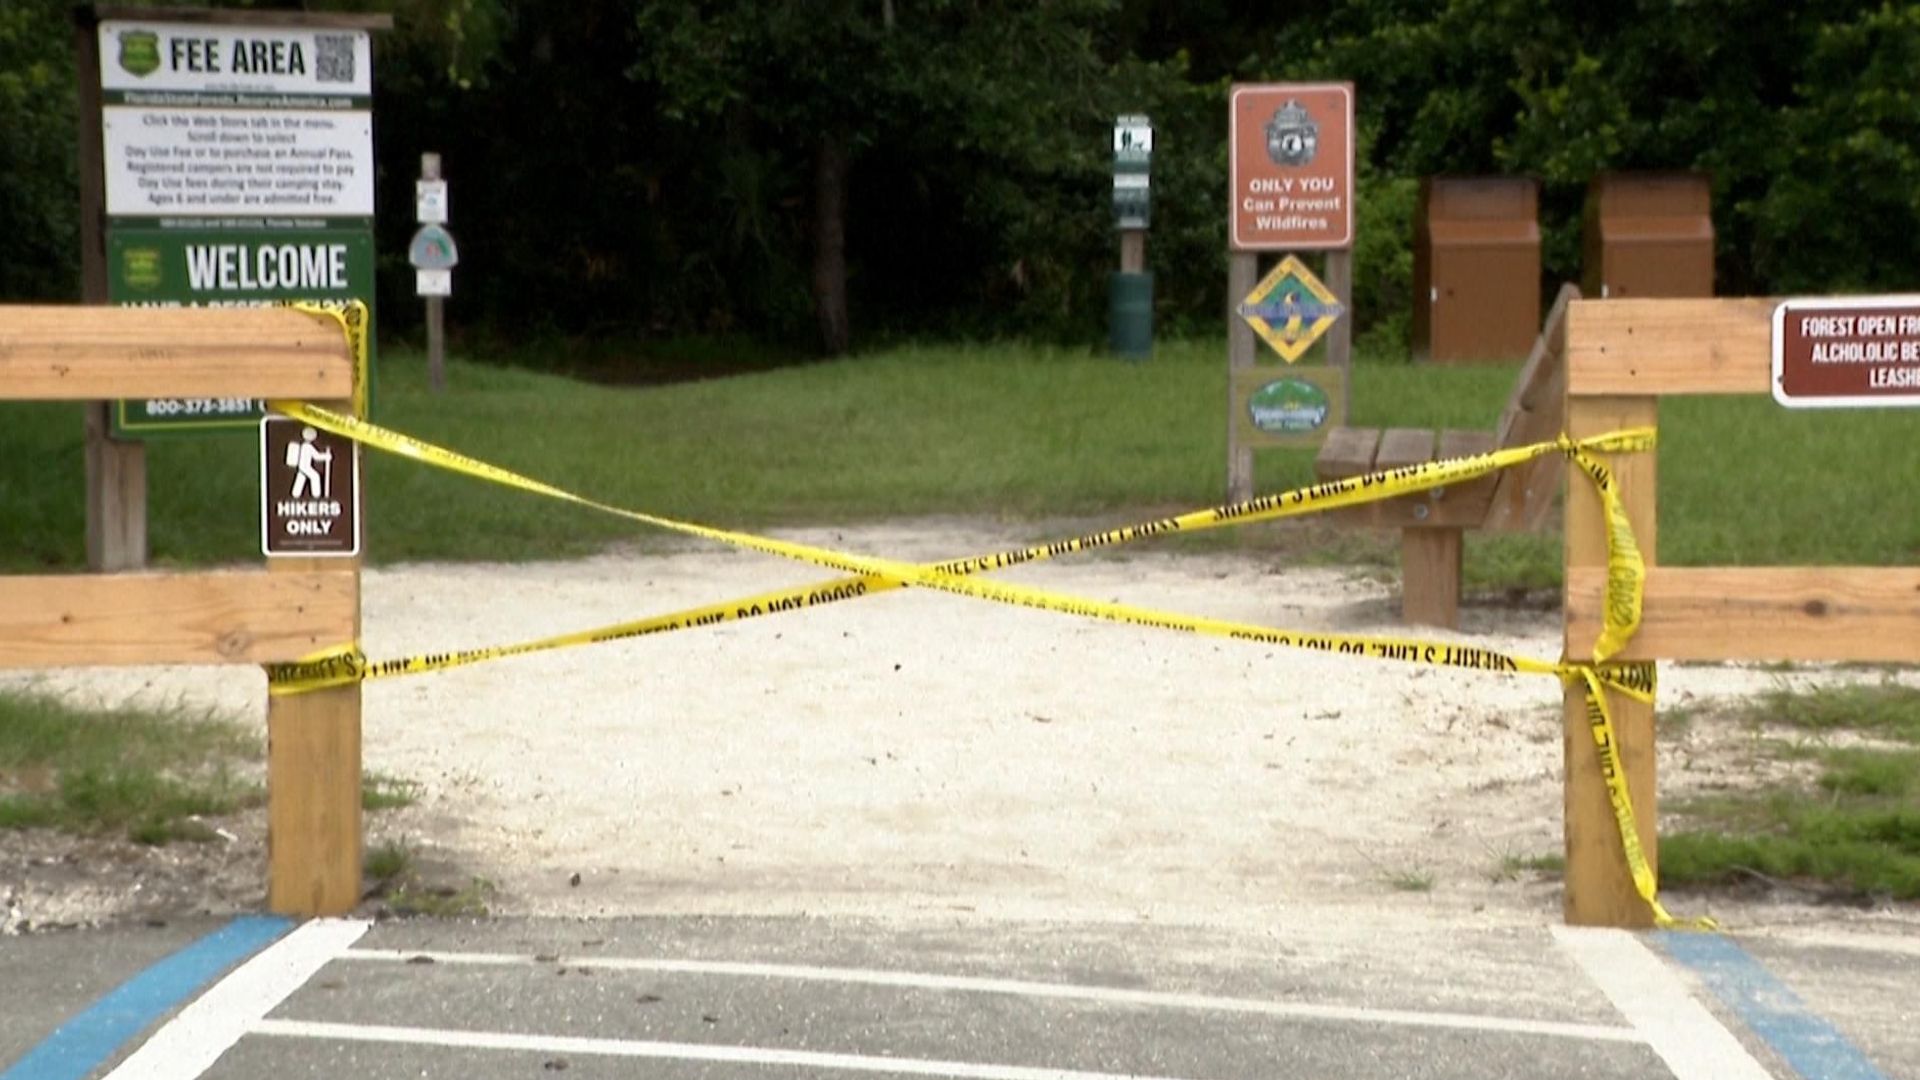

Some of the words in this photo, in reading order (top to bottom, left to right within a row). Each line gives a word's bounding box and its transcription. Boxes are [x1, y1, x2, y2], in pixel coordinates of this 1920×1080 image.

[170, 38, 221, 74] FEE
[231, 39, 306, 75] AREA
[142, 114, 168, 127] Click
[171, 115, 190, 127] the
[193, 116, 217, 128] Web
[220, 116, 248, 128] Store
[250, 117, 268, 129] tab
[270, 118, 281, 129] in
[283, 118, 300, 129] the
[187, 131, 216, 142] Scroll
[220, 131, 249, 143] down
[252, 133, 263, 143] to
[266, 132, 297, 144] select
[125, 145, 146, 159] Day
[149, 146, 170, 158] Use
[173, 146, 192, 158] Fee
[194, 148, 206, 158] or
[209, 147, 221, 158] to
[223, 147, 271, 161] purchase
[275, 149, 287, 159] an
[290, 147, 327, 160] Annual
[127, 161, 185, 175] Registered
[187, 164, 233, 176] campers
[236, 164, 254, 175] are
[256, 163, 273, 175] not
[275, 163, 320, 177] required
[322, 163, 335, 175] to
[336, 165, 356, 178] pay
[138, 177, 159, 191] Day
[161, 178, 182, 190] Use
[185, 177, 208, 190] fees
[210, 178, 245, 193] during
[247, 178, 273, 191] their
[275, 180, 320, 194] camping
[1249, 178, 1294, 193] ONLY
[1300, 177, 1335, 192] YOU
[148, 193, 174, 207] Ages
[186, 193, 207, 205] and
[209, 194, 241, 206] under
[243, 195, 261, 206] are
[264, 193, 311, 207] admitted
[1243, 197, 1275, 212] Can
[1279, 196, 1341, 212] Prevent
[1256, 216, 1329, 230] Wildfires
[184, 243, 349, 291] WELCOME
[1801, 315, 1856, 338] FOREST
[1857, 314, 1897, 336] OPEN
[1811, 341, 1898, 363] ALCHOLOLIC
[277, 501, 341, 517] HIKERS
[286, 519, 333, 535] ONLY
